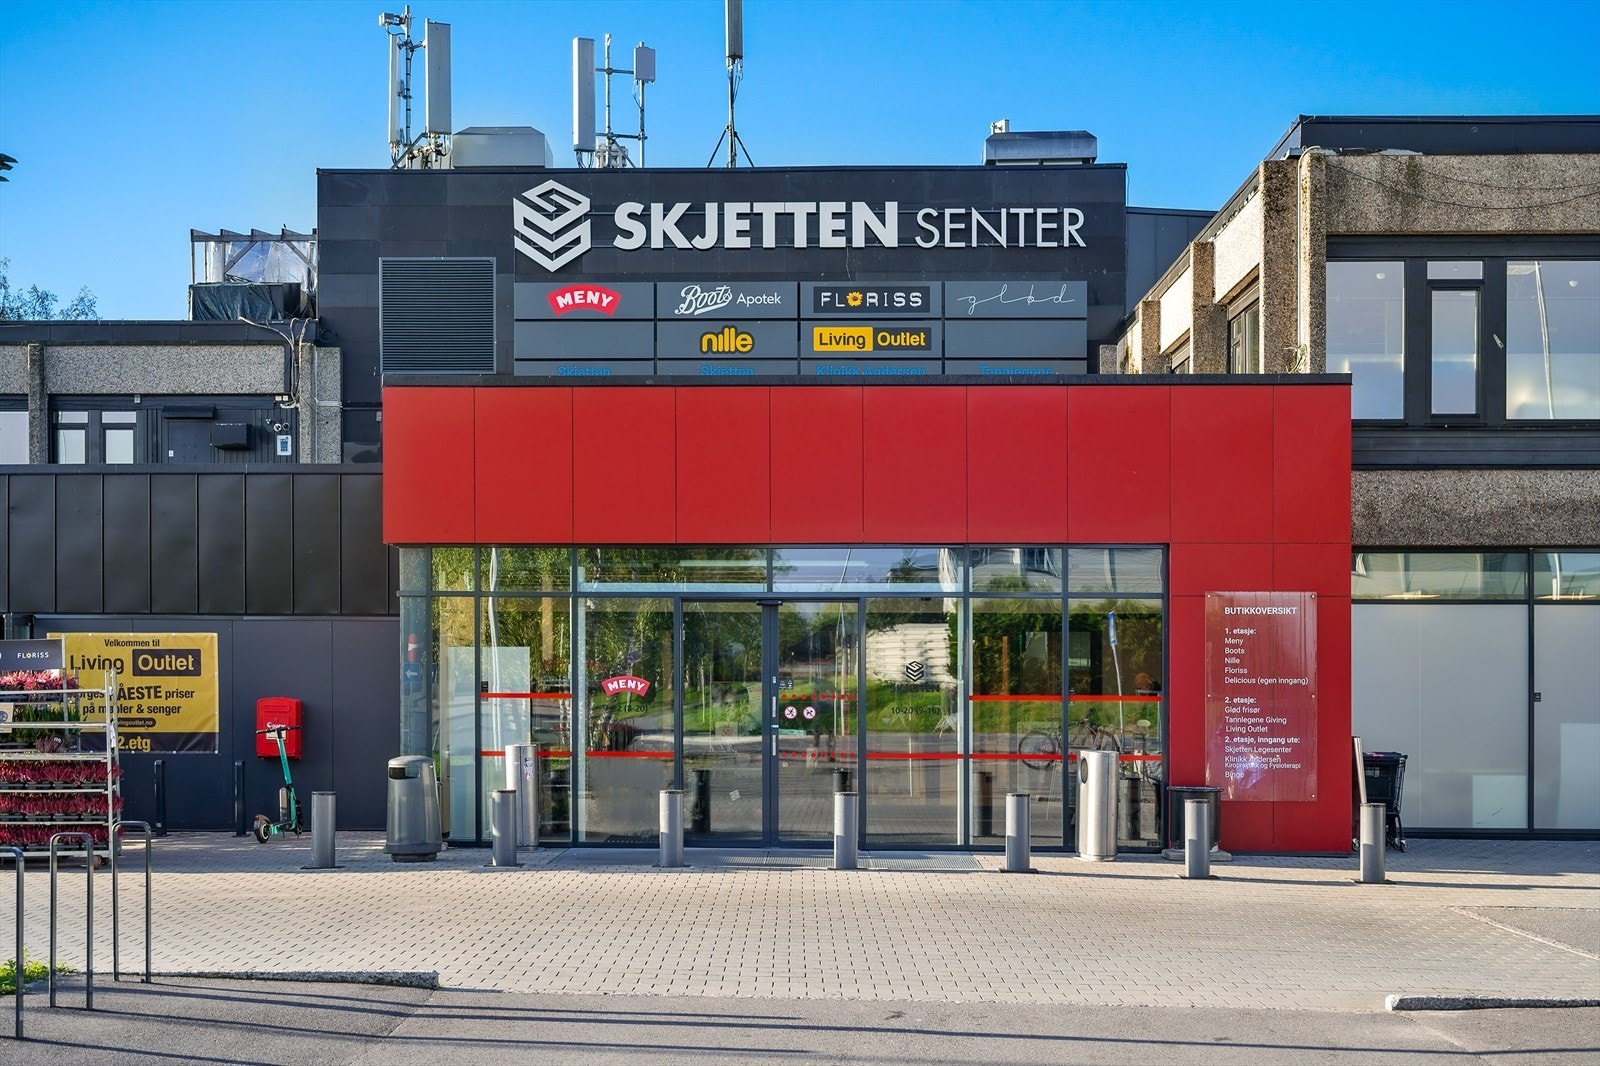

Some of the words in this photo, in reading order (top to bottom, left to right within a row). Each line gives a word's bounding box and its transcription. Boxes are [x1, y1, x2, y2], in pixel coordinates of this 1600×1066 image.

[613, 201, 898, 250] SKJETTEN
[915, 207, 1086, 248] SENTER
[556, 290, 613, 308] MENY
[674, 285, 732, 315] Boots
[736, 293, 781, 307] Apotek
[821, 292, 922, 307] FLORISS
[702, 327, 753, 352] nille
[819, 332, 866, 349] Living
[877, 332, 926, 346] Outlet
[816, 365, 860, 375] Klinikk
[1224, 607, 1297, 615] BUTIKKOVERSIKT
[1233, 628, 1256, 636] etasje:
[104, 639, 150, 647] Velkommen
[152, 639, 160, 647] til
[1225, 638, 1244, 646] Meny
[70, 655, 124, 674] Living
[138, 654, 194, 670] Outlet
[607, 680, 645, 691] MENY
[1257, 677, 1277, 685] (egen
[1279, 677, 1309, 685] inngang)
[165, 689, 195, 700] priser
[1233, 697, 1256, 705] etasje:
[82, 702, 95, 715] på
[136, 704, 144, 713] &
[147, 704, 181, 716] senger
[1225, 716, 1264, 724] Tannlegene
[1265, 716, 1287, 725] Giving
[1233, 736, 1256, 744] etasje,
[1258, 736, 1286, 744] inngang
[1225, 746, 1252, 754] Skjetten
[1254, 746, 1292, 754] Legesenter
[1225, 771, 1244, 779] Bingo
